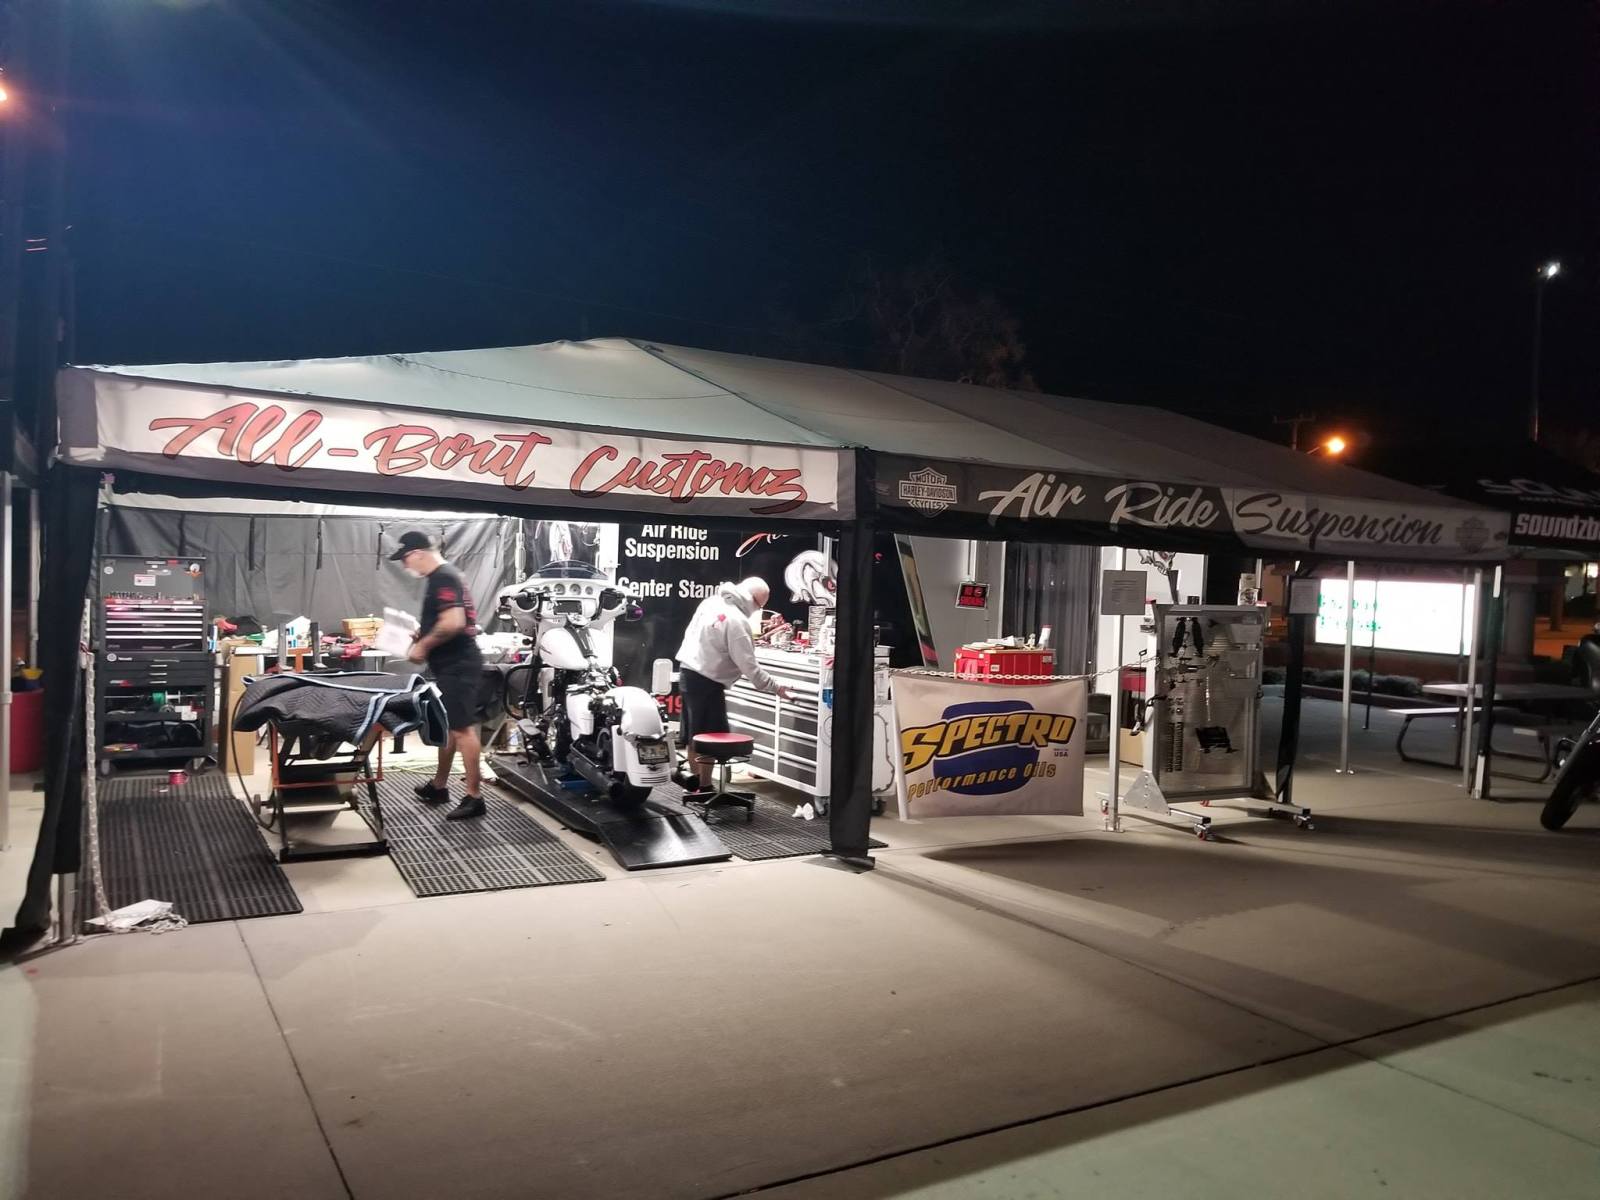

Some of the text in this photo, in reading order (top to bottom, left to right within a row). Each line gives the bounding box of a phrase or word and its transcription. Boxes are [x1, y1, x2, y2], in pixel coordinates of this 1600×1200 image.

[570, 445, 807, 514] Customz
[978, 472, 1087, 527] Air
[1104, 482, 1220, 532] Ride
[1235, 493, 1445, 549] Suspension
[625, 538, 719, 562] Suspension
[901, 713, 1077, 775] SPECTRO
[907, 762, 1056, 802] Performance Oils
